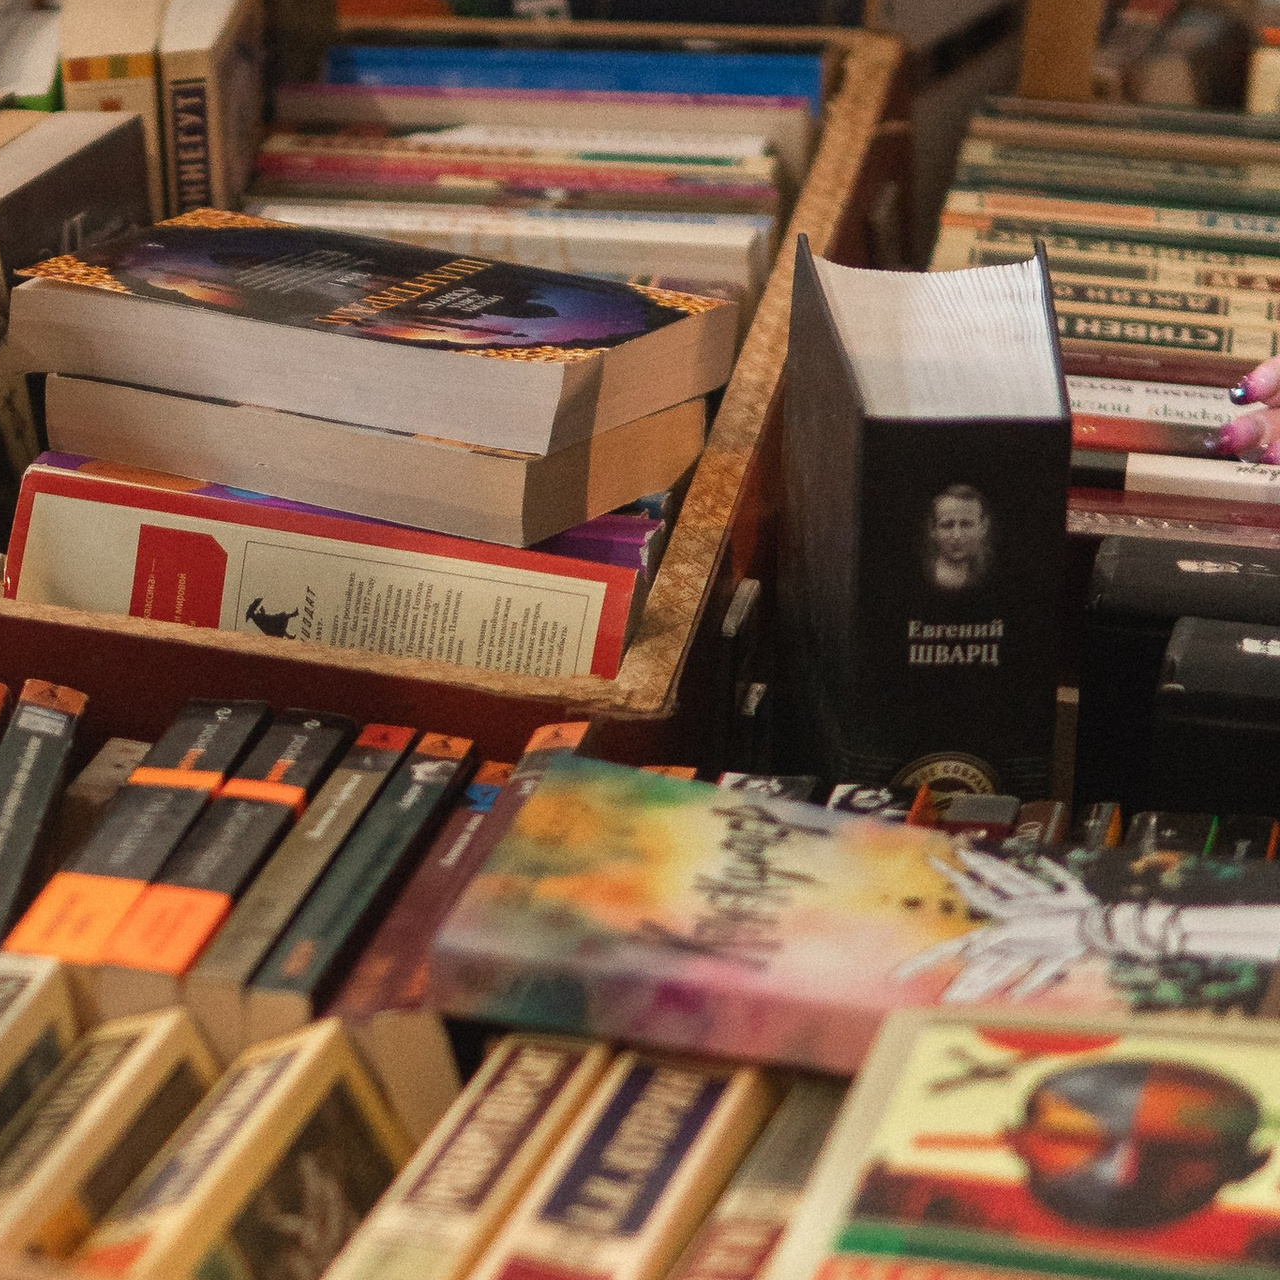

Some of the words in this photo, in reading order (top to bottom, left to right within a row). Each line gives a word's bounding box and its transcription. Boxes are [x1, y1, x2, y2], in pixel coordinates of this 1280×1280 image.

[175, 95, 208, 205] ННЕГУТ
[1076, 317, 1219, 346] СТИВЕН
[170, 572, 190, 614] мировой
[362, 596, 371, 615] 1917
[297, 585, 319, 643] ИЗДАТ
[908, 619, 1004, 639] Евгений
[908, 644, 999, 666] ШВАРЦ
